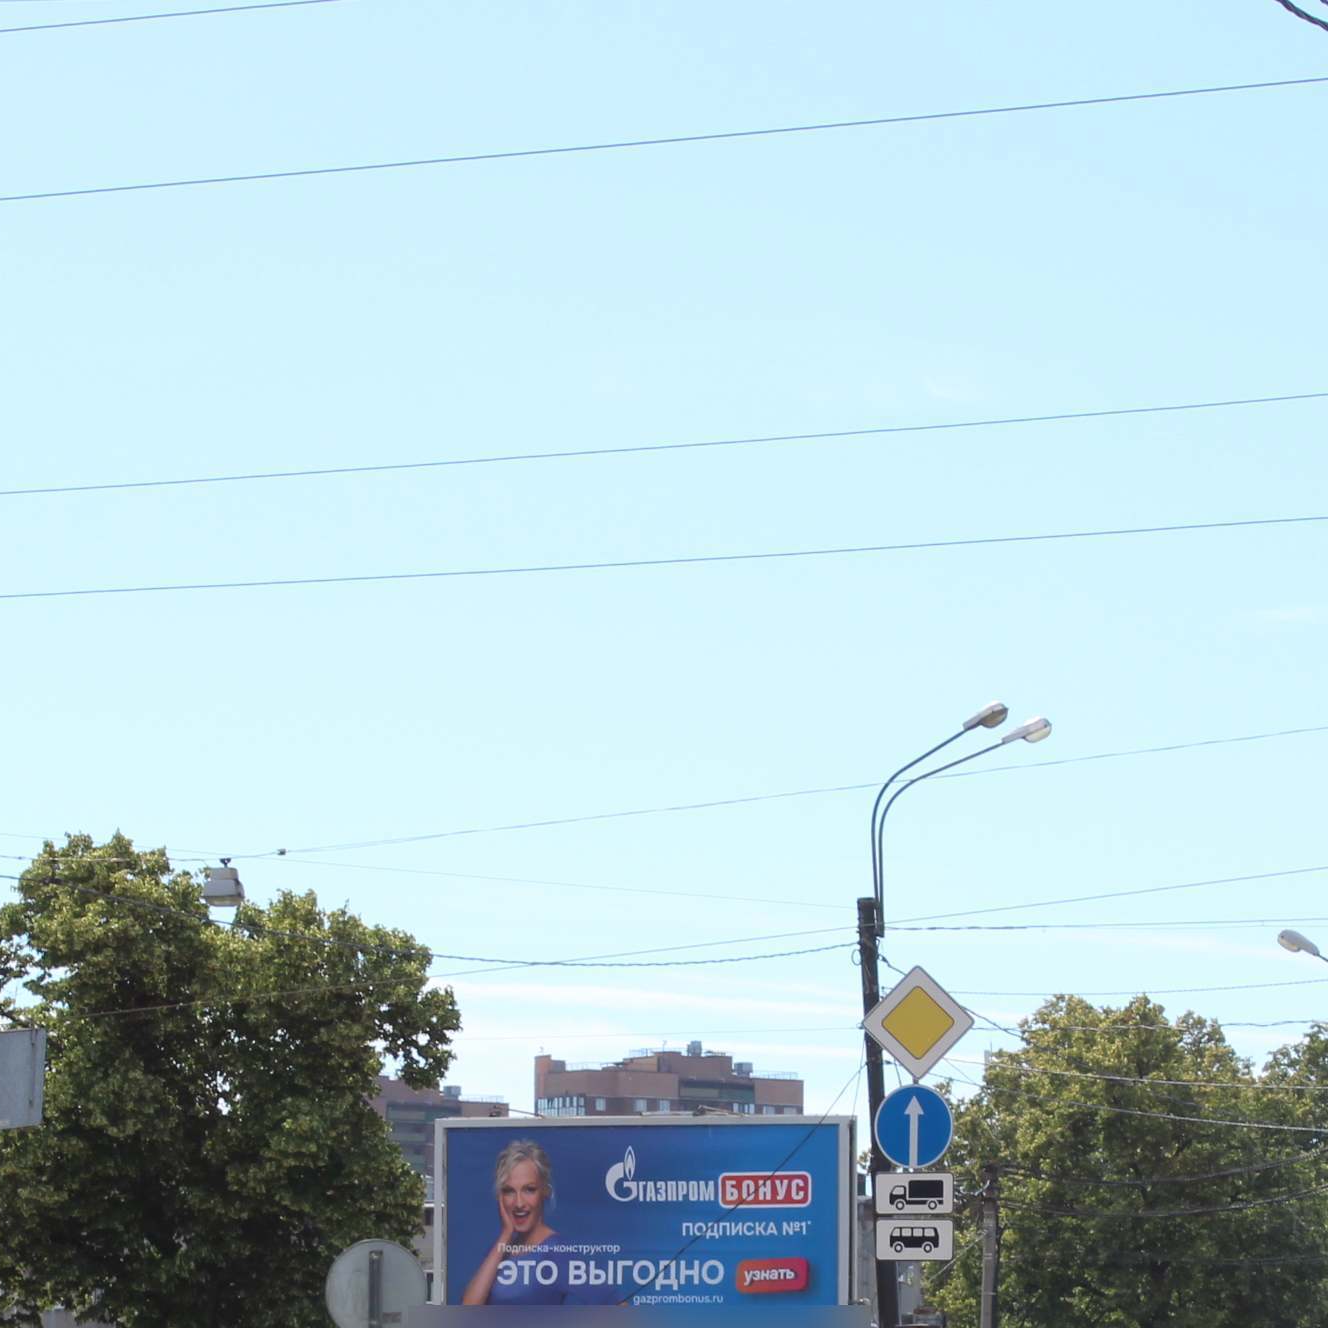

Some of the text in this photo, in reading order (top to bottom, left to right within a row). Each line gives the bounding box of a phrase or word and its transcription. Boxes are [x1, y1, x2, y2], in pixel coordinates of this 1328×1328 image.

[638, 1179, 805, 1202] ГАЗПРОМ БОНУС
[682, 1222, 777, 1239] ПОДПИСКА
[497, 1243, 621, 1254] Подписка-конструктор
[497, 1260, 725, 1291] ЭТО ВЫГОДНО
[744, 1267, 795, 1286] узнать
[633, 1293, 724, 1305] gazprombonus.ru
